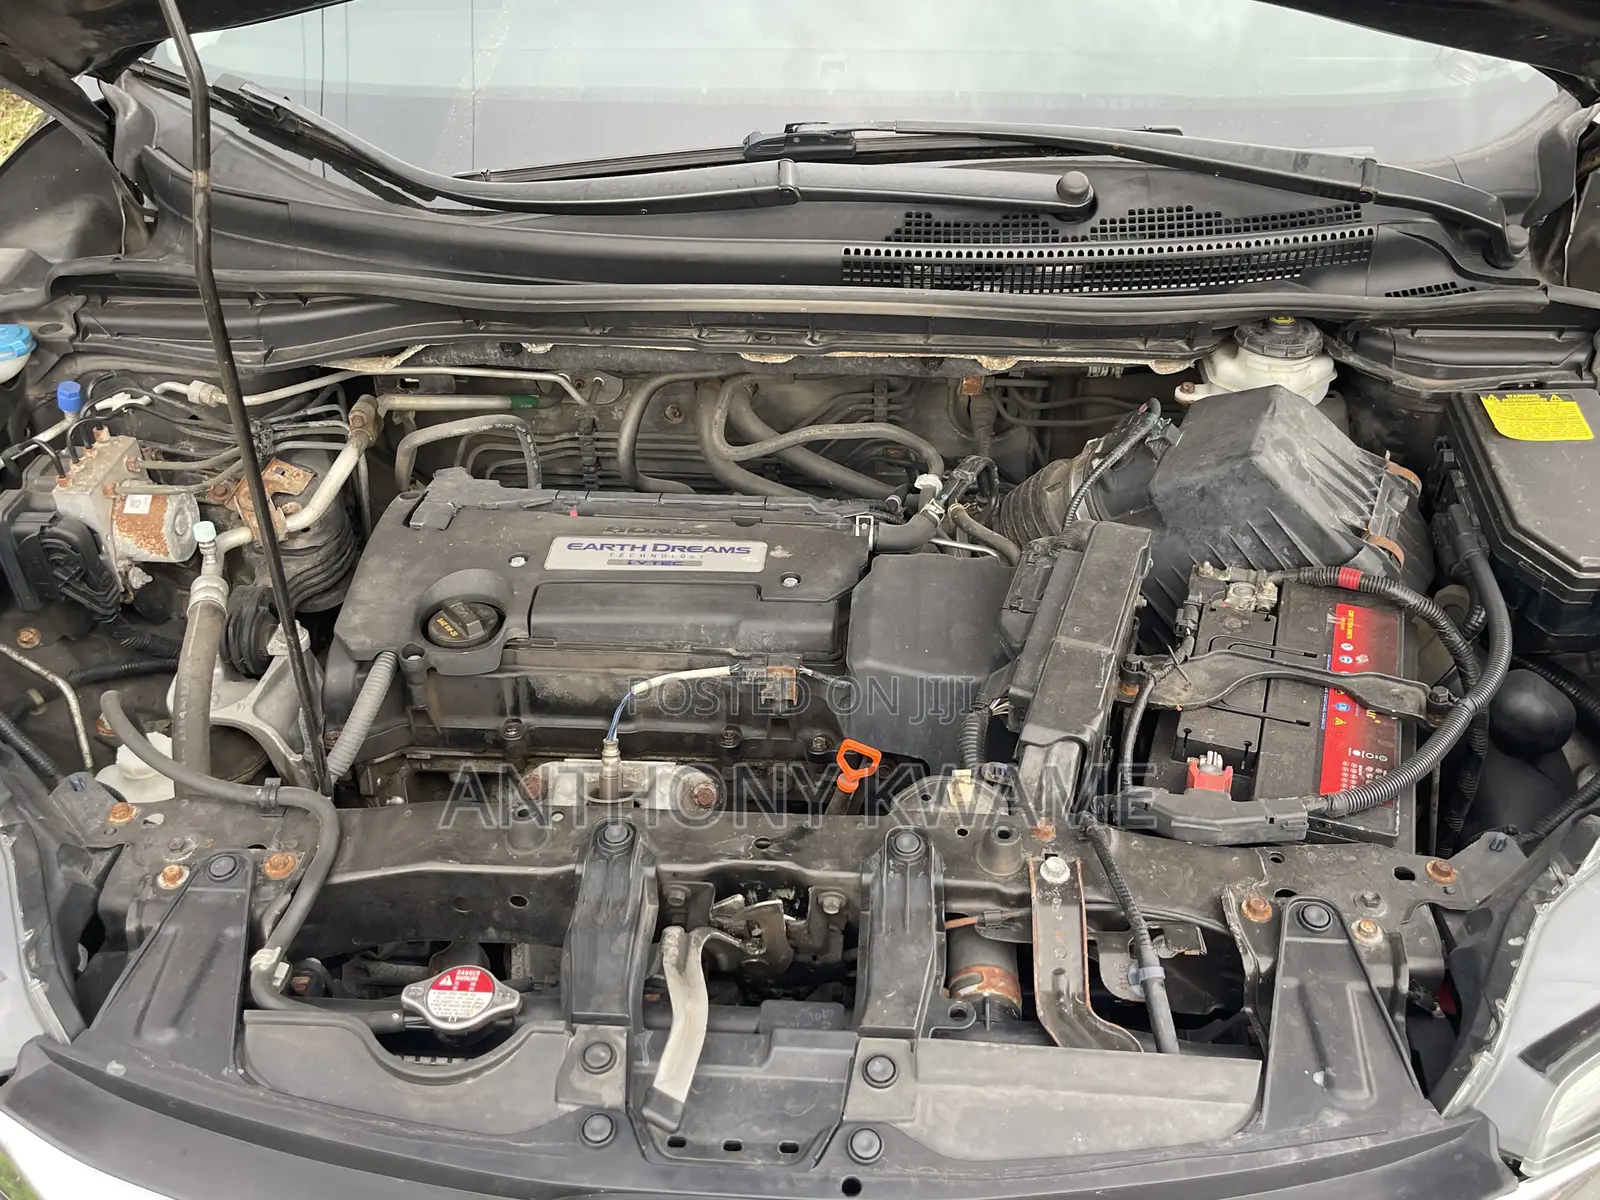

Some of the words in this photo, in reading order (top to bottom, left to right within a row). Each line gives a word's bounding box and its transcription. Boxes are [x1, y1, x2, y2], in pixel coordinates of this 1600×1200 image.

[567, 542, 647, 552] EARTH
[653, 543, 751, 555] DREAMS
[609, 552, 705, 560] TECHNOLOGY
